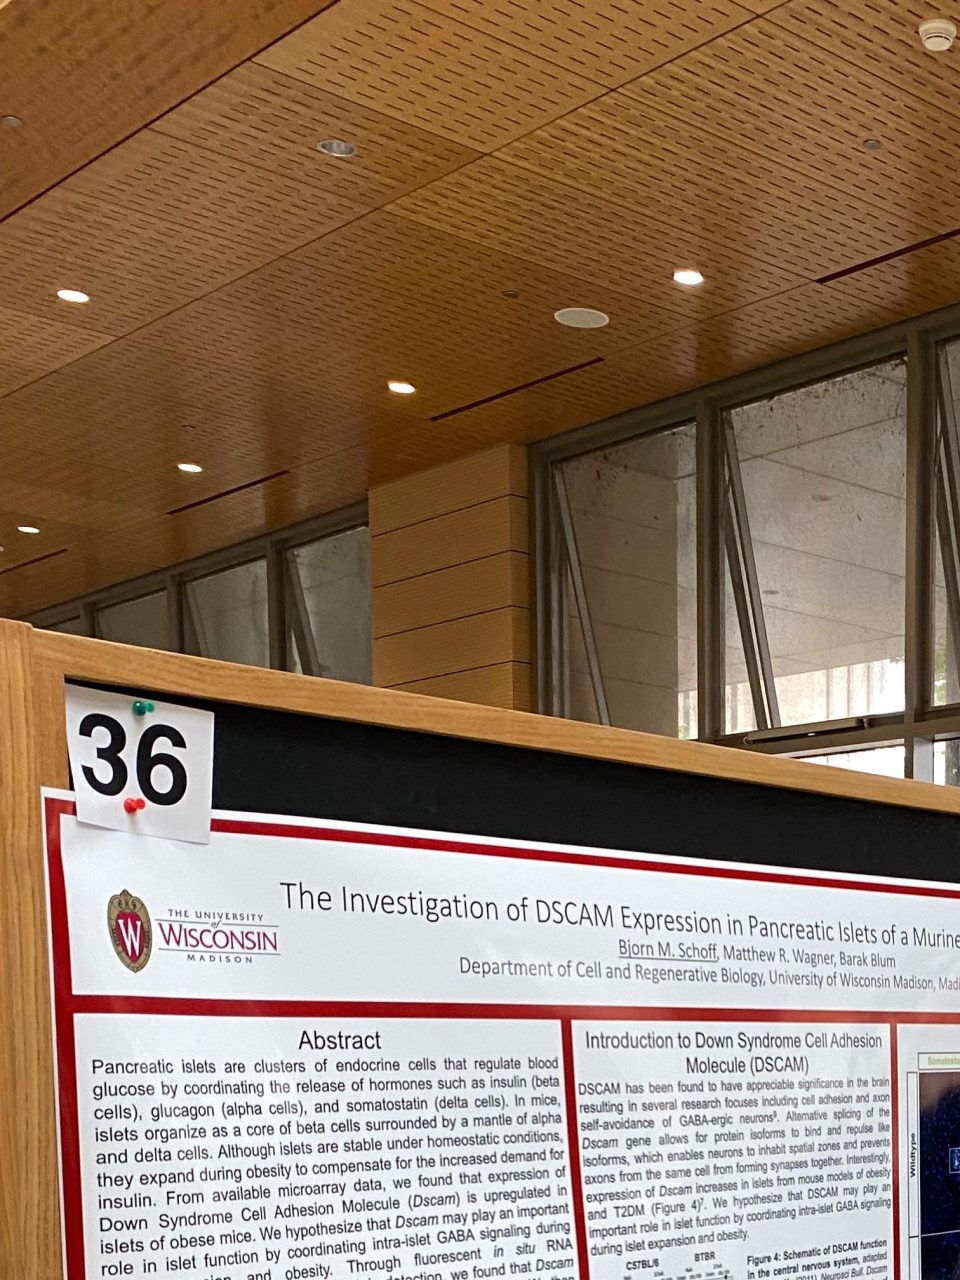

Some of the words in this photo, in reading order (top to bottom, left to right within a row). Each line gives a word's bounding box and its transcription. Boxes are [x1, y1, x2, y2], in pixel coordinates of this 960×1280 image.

[78, 712, 187, 806] 36
[168, 909, 189, 918] THE
[195, 911, 263, 922] UNIVERSITY
[280, 881, 332, 911] The
[342, 886, 498, 923] Investigation
[507, 897, 528, 922] of
[536, 899, 614, 928] DSCAM
[621, 906, 722, 935] Expression
[727, 913, 743, 936] in
[748, 915, 834, 941] Pancreatic
[838, 921, 877, 944] Islets
[882, 924, 896, 945] of
[901, 931, 908, 946] a
[210, 920, 222, 929] of
[117, 919, 141, 957] W
[158, 923, 277, 951] WISCONSIN
[187, 954, 252, 964] MADISON
[618, 940, 654, 958] Bjorn
[658, 941, 675, 957] M.
[678, 942, 720, 962] Schoff,
[723, 945, 776, 962] Matthew
[779, 948, 790, 963] R.
[792, 948, 837, 968] Wagner,
[839, 951, 868, 967] Barak
[871, 953, 896, 968] Blum
[460, 957, 553, 978] Department
[557, 959, 572, 977] of
[576, 961, 602, 978] Cell
[605, 962, 631, 979] and
[635, 964, 717, 984] Regenerative
[721, 967, 766, 988] Biology,
[769, 969, 824, 990] University
[826, 971, 837, 987] of
[839, 973, 891, 989] Wisconsin
[893, 974, 936, 992] Madison,
[298, 1030, 382, 1050] Abstract
[586, 1031, 673, 1049] Introduction
[677, 1032, 691, 1049] to
[695, 1032, 733, 1048] Down
[738, 1032, 801, 1052] Syndrome
[805, 1032, 828, 1048] Cell
[830, 1032, 882, 1048] Adhesion
[92, 1059, 174, 1074] Pancreatic
[181, 1059, 216, 1073] islets
[224, 1062, 245, 1073] are
[254, 1059, 306, 1073] clusters
[314, 1058, 328, 1072] of
[336, 1058, 400, 1072] endocrine
[408, 1057, 437, 1071] cells
[444, 1057, 467, 1070] that
[474, 1057, 521, 1073] regulate
[528, 1056, 559, 1069] blood
[686, 1056, 746, 1074] Molecule
[750, 1056, 809, 1077] (DSCAM)
[93, 1081, 155, 1101] glucose
[161, 1081, 178, 1099] by
[184, 1080, 264, 1097] coordinating
[269, 1079, 290, 1094] the
[296, 1079, 346, 1093] release
[351, 1078, 364, 1092] of
[369, 1078, 433, 1091] hormones
[437, 1076, 466, 1090] such
[471, 1079, 486, 1089] as
[490, 1075, 527, 1088] insulin
[531, 1075, 560, 1091] (beta
[578, 1082, 621, 1095] DSCAM
[625, 1082, 644, 1094] has
[648, 1081, 674, 1094] been
[677, 1080, 704, 1093] found
[708, 1081, 717, 1092] to
[720, 1080, 743, 1092] have
[746, 1079, 795, 1093] appreciable
[798, 1077, 844, 1092] significance
[847, 1077, 854, 1088] in
[857, 1077, 869, 1088] the
[872, 1077, 889, 1087] brain
[694, 1251, 715, 1262] BTBR
